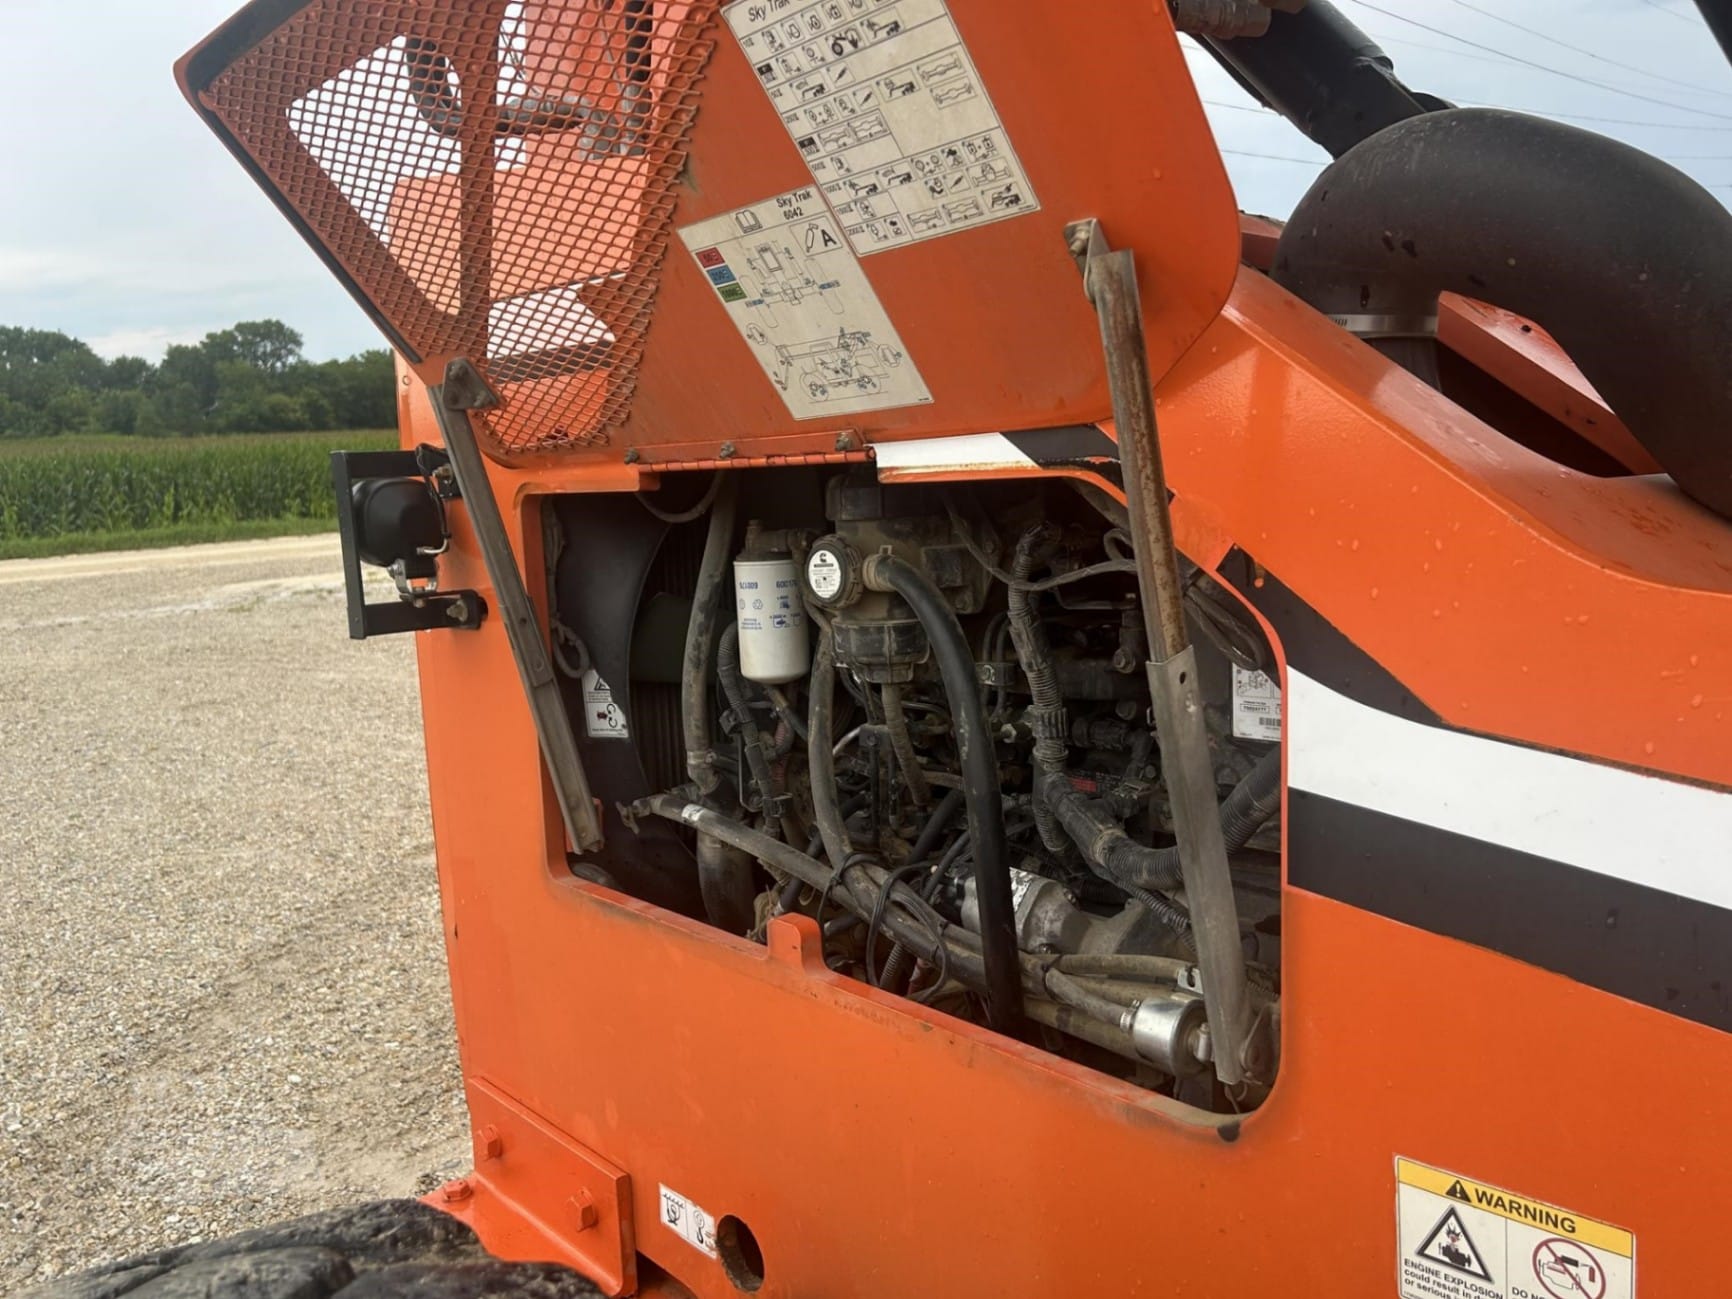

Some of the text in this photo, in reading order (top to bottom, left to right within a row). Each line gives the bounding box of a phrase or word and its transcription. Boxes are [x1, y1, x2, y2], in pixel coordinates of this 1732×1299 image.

[748, 5, 767, 22] Sky
[776, 190, 812, 208] Sky Trak
[783, 207, 804, 220] 6042
[821, 229, 838, 247] A
[1474, 1187, 1577, 1234] WARNING
[1404, 1258, 1503, 1299] ENGINE EXPLOSION
[1404, 1269, 1430, 1284] could
[1432, 1279, 1460, 1296] result
[1404, 1278, 1414, 1287] or
[1416, 1282, 1452, 1299] serious
[1512, 1286, 1528, 1299] DO
